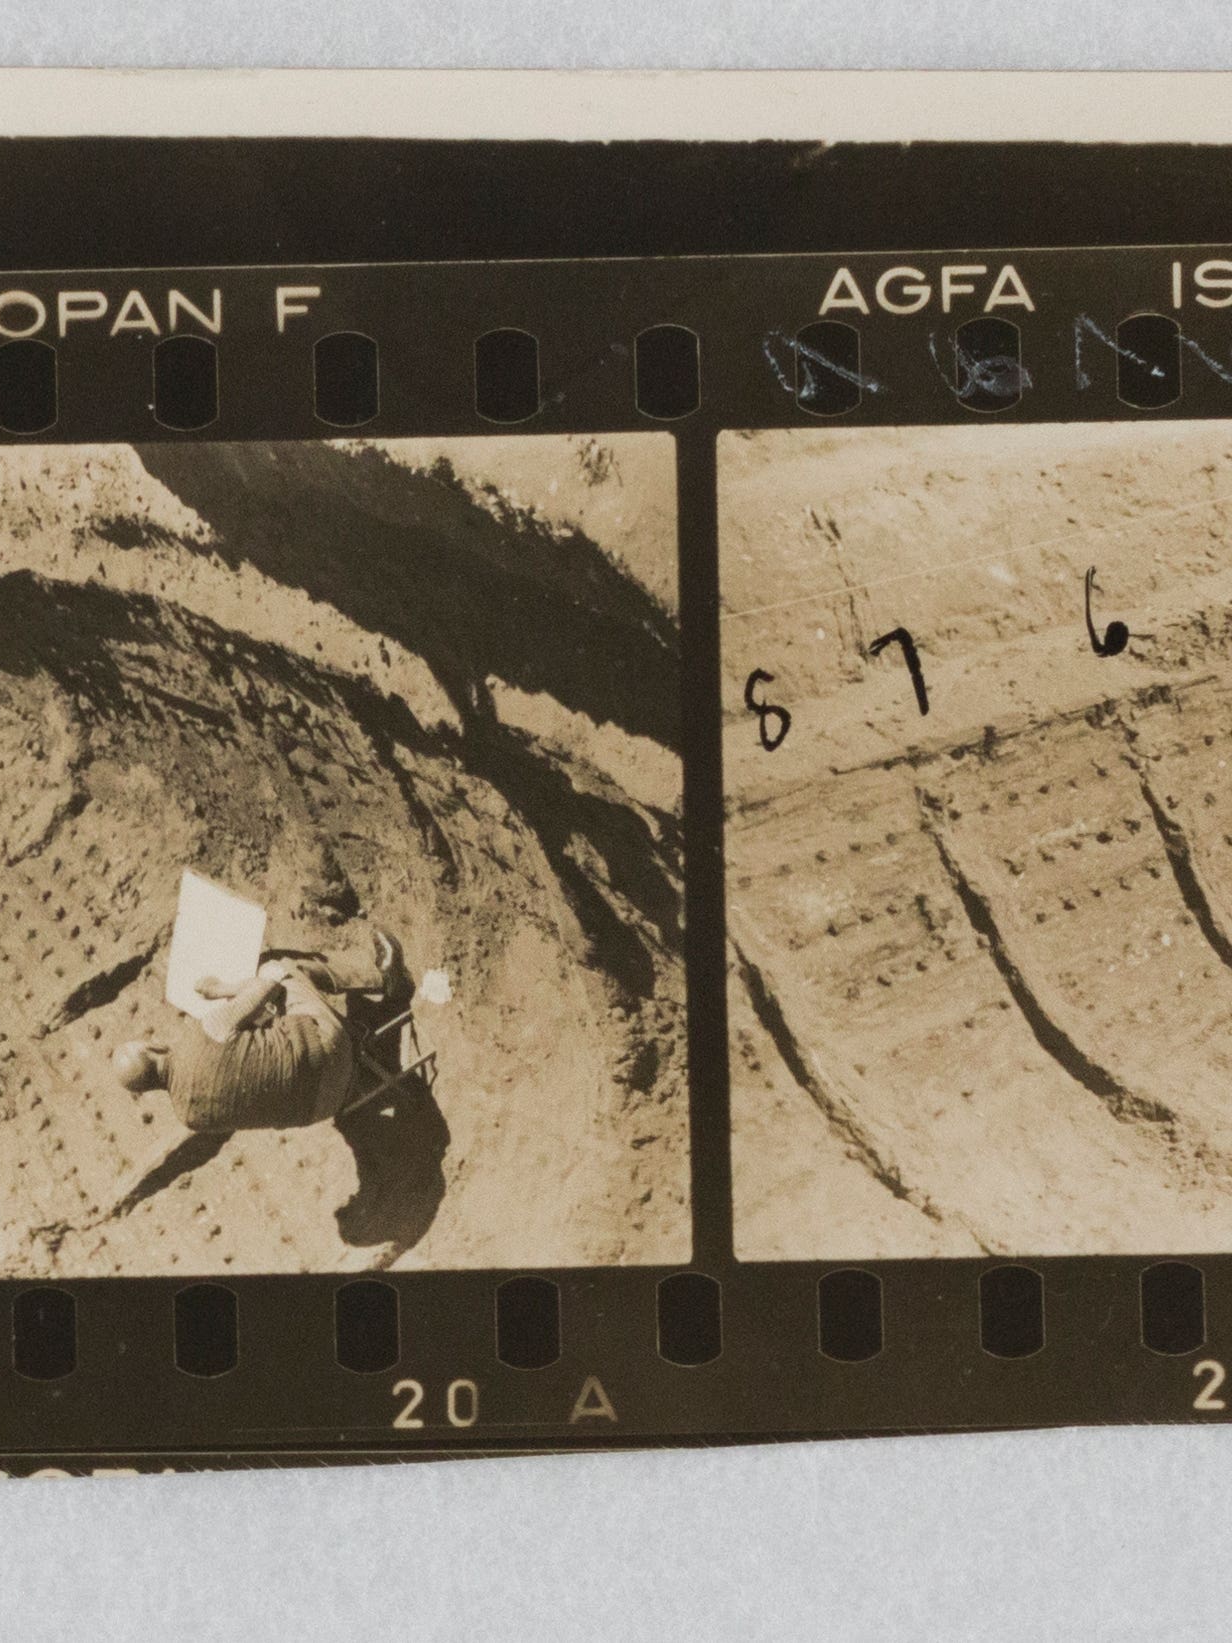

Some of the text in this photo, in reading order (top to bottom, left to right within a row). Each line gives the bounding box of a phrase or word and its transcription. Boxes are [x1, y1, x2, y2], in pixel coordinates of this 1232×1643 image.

[274, 285, 322, 334] F
[818, 264, 1036, 316] AGFA
[1085, 566, 1130, 658] 6
[869, 627, 930, 716] 7
[744, 669, 791, 752] 8
[392, 1375, 619, 1429] 20 A
[1192, 1358, 1227, 1411] 2
